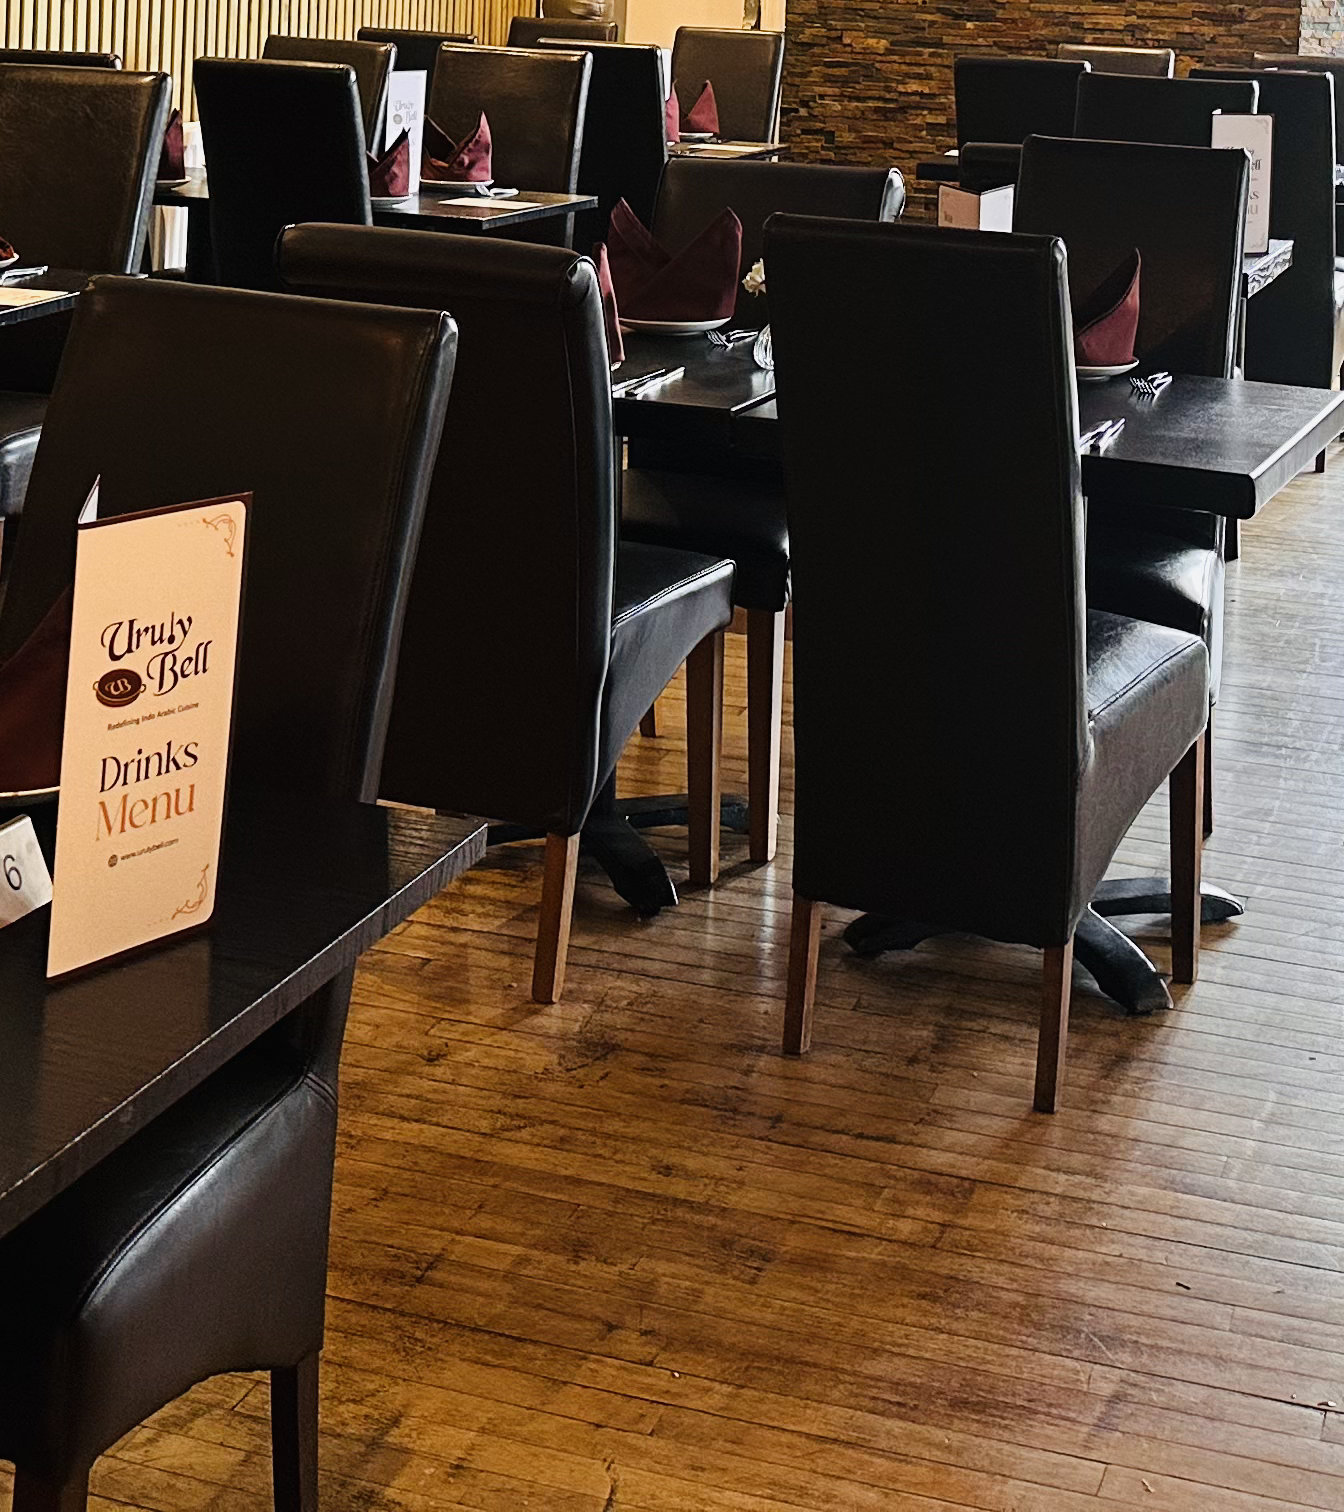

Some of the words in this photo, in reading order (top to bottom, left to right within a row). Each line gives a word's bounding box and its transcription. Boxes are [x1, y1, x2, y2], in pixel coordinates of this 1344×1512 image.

[100, 610, 193, 662] Uruly
[146, 639, 213, 697] Bell
[99, 739, 199, 793] Drinks
[95, 783, 195, 842] Menu
[2, 853, 23, 891] 6
